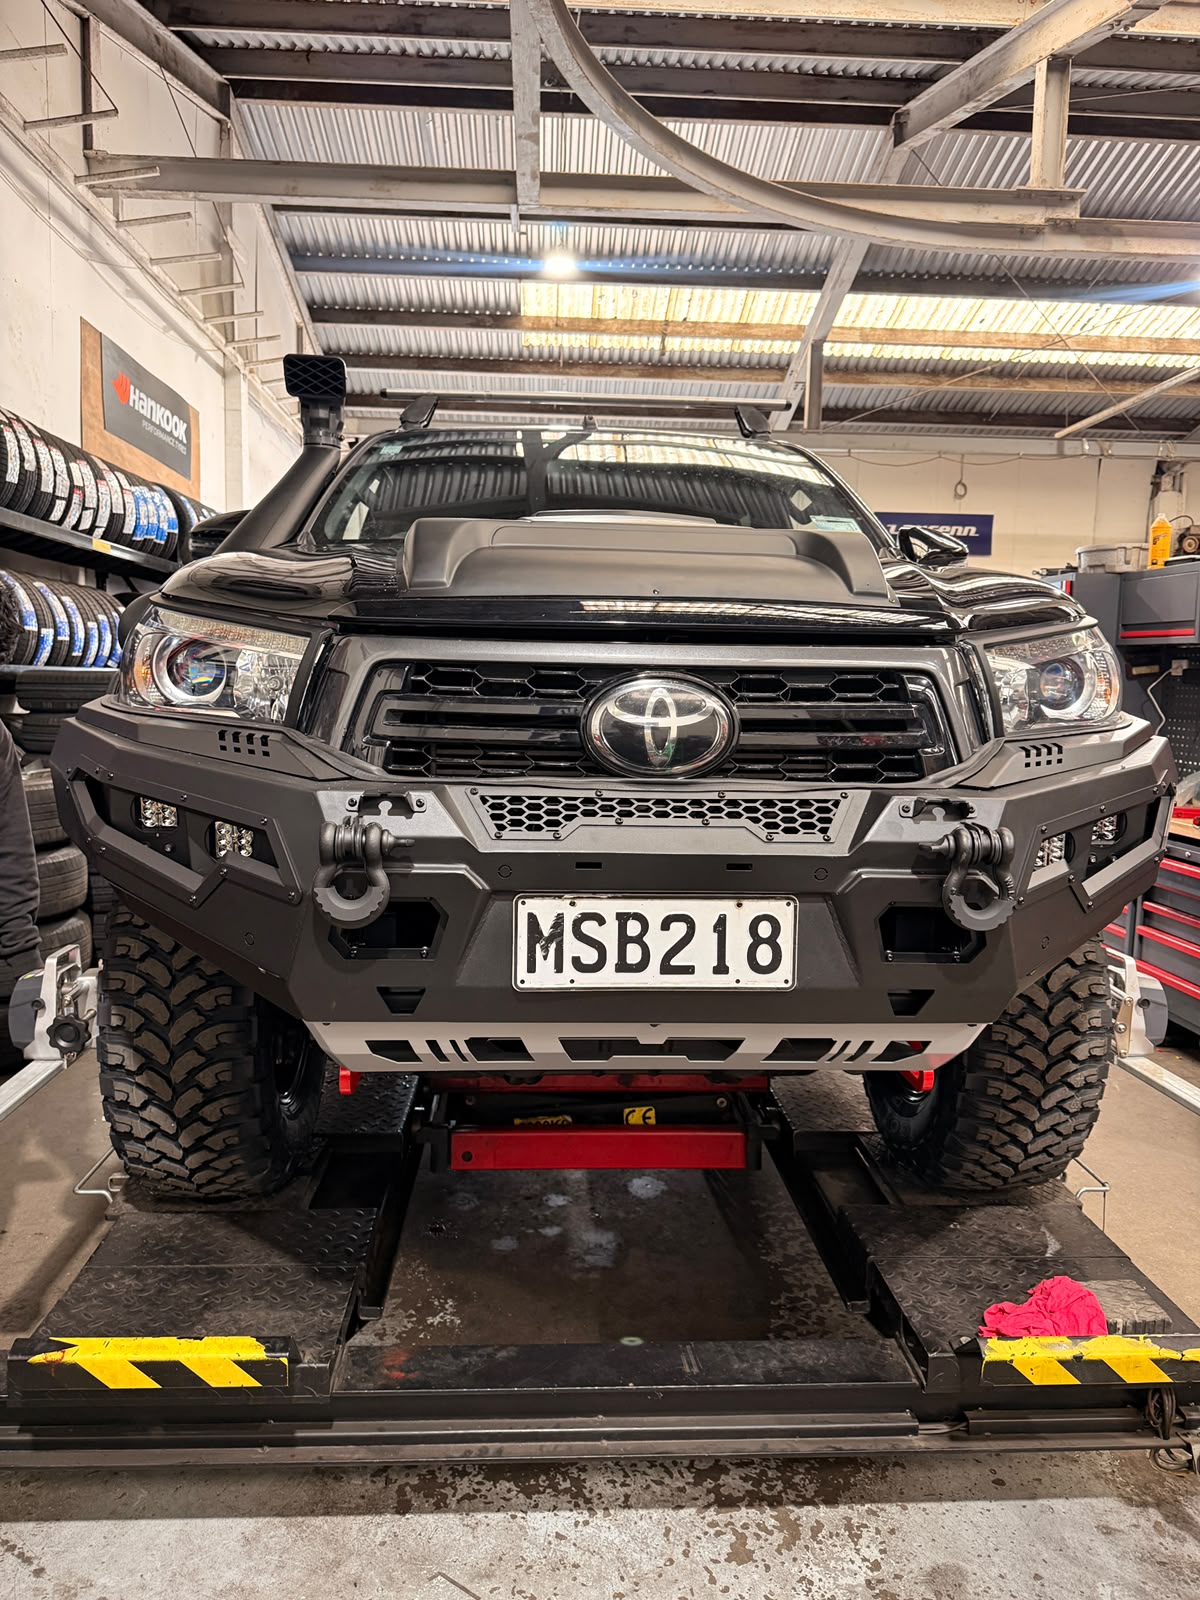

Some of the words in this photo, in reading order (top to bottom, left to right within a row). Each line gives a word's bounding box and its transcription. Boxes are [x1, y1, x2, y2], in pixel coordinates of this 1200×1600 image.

[142, 419, 175, 448] PERFORMANCE
[526, 911, 783, 975] MSB218
[625, 1107, 653, 1125] CE
